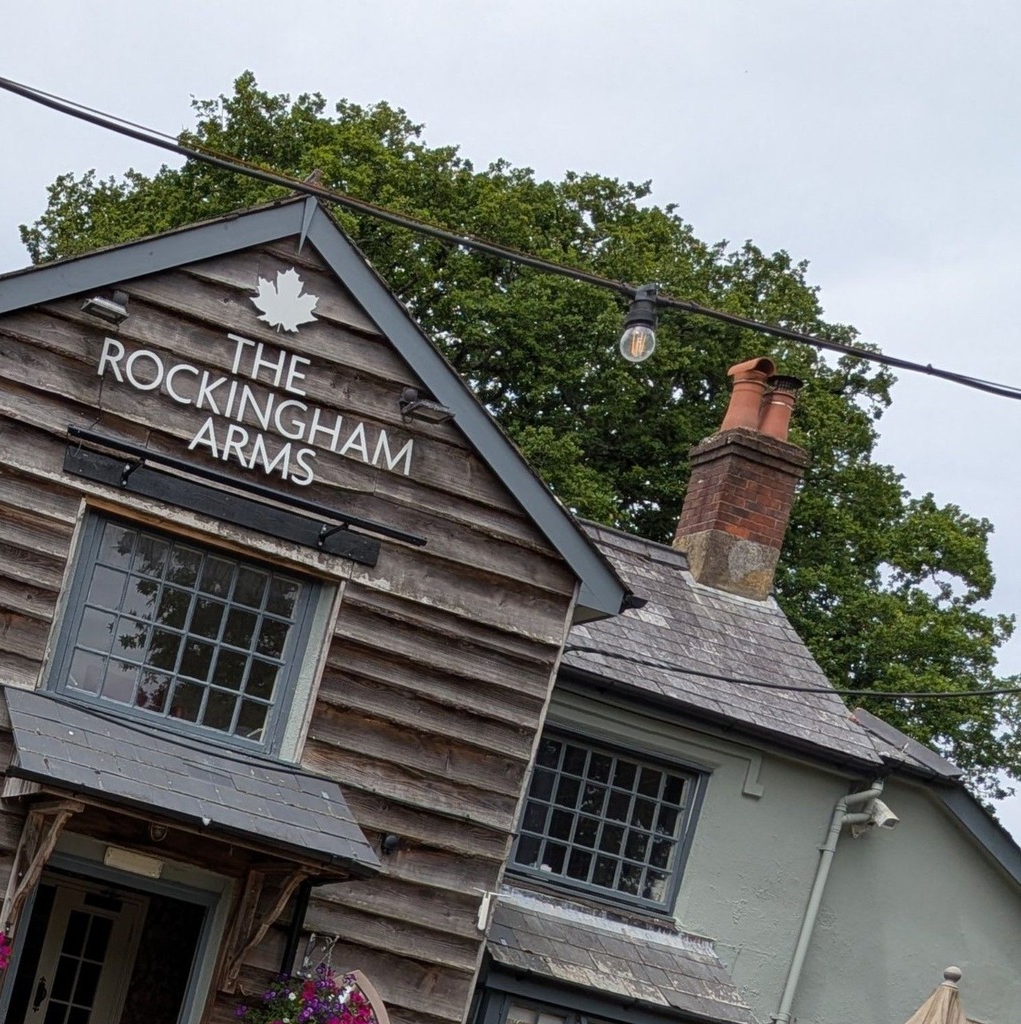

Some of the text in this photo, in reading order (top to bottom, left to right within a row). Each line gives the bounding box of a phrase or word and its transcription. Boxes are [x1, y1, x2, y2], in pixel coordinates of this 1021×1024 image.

[227, 333, 311, 396] THE
[97, 337, 414, 476] ROCKINGHAM
[188, 416, 316, 486] ARMS
